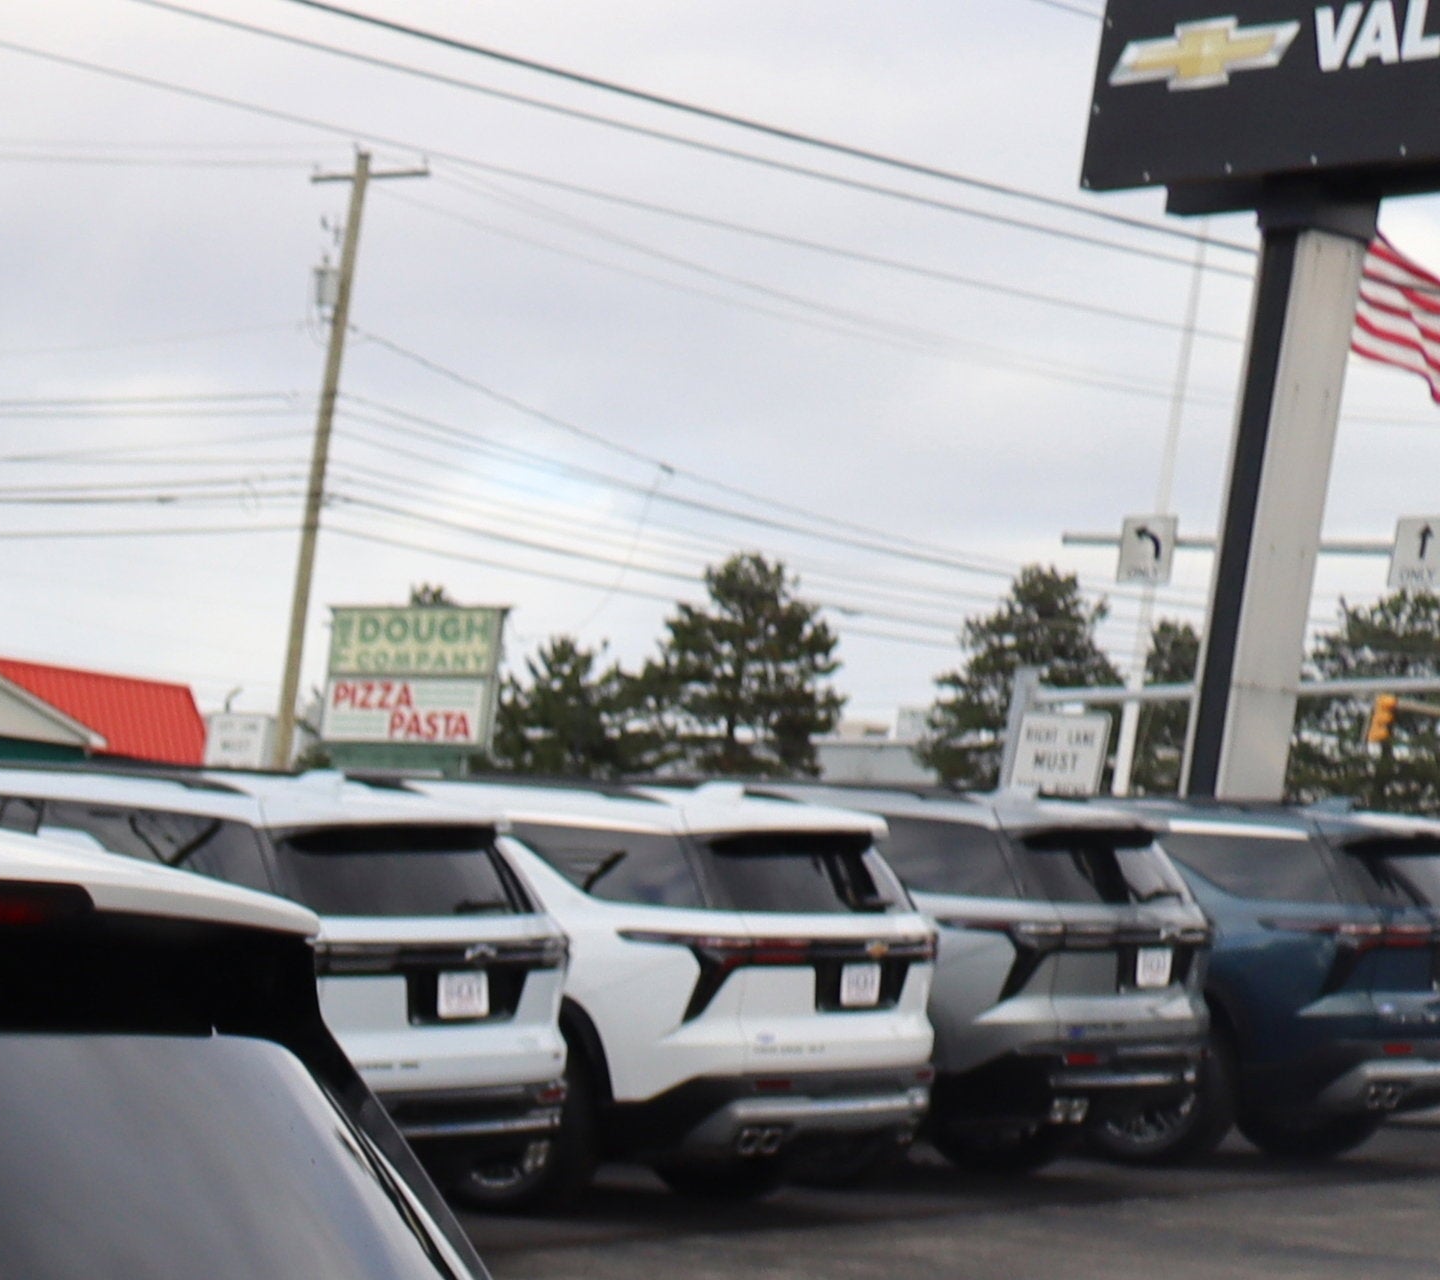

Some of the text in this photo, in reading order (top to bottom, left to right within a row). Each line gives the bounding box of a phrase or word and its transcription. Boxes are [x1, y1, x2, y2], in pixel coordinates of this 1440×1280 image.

[1313, 0, 1440, 73] VAL
[358, 615, 491, 645] DOUGH
[357, 650, 488, 671] COMPANY
[333, 681, 413, 710] PIZZA
[388, 711, 472, 741] PASTA
[1033, 749, 1078, 772] MUST
